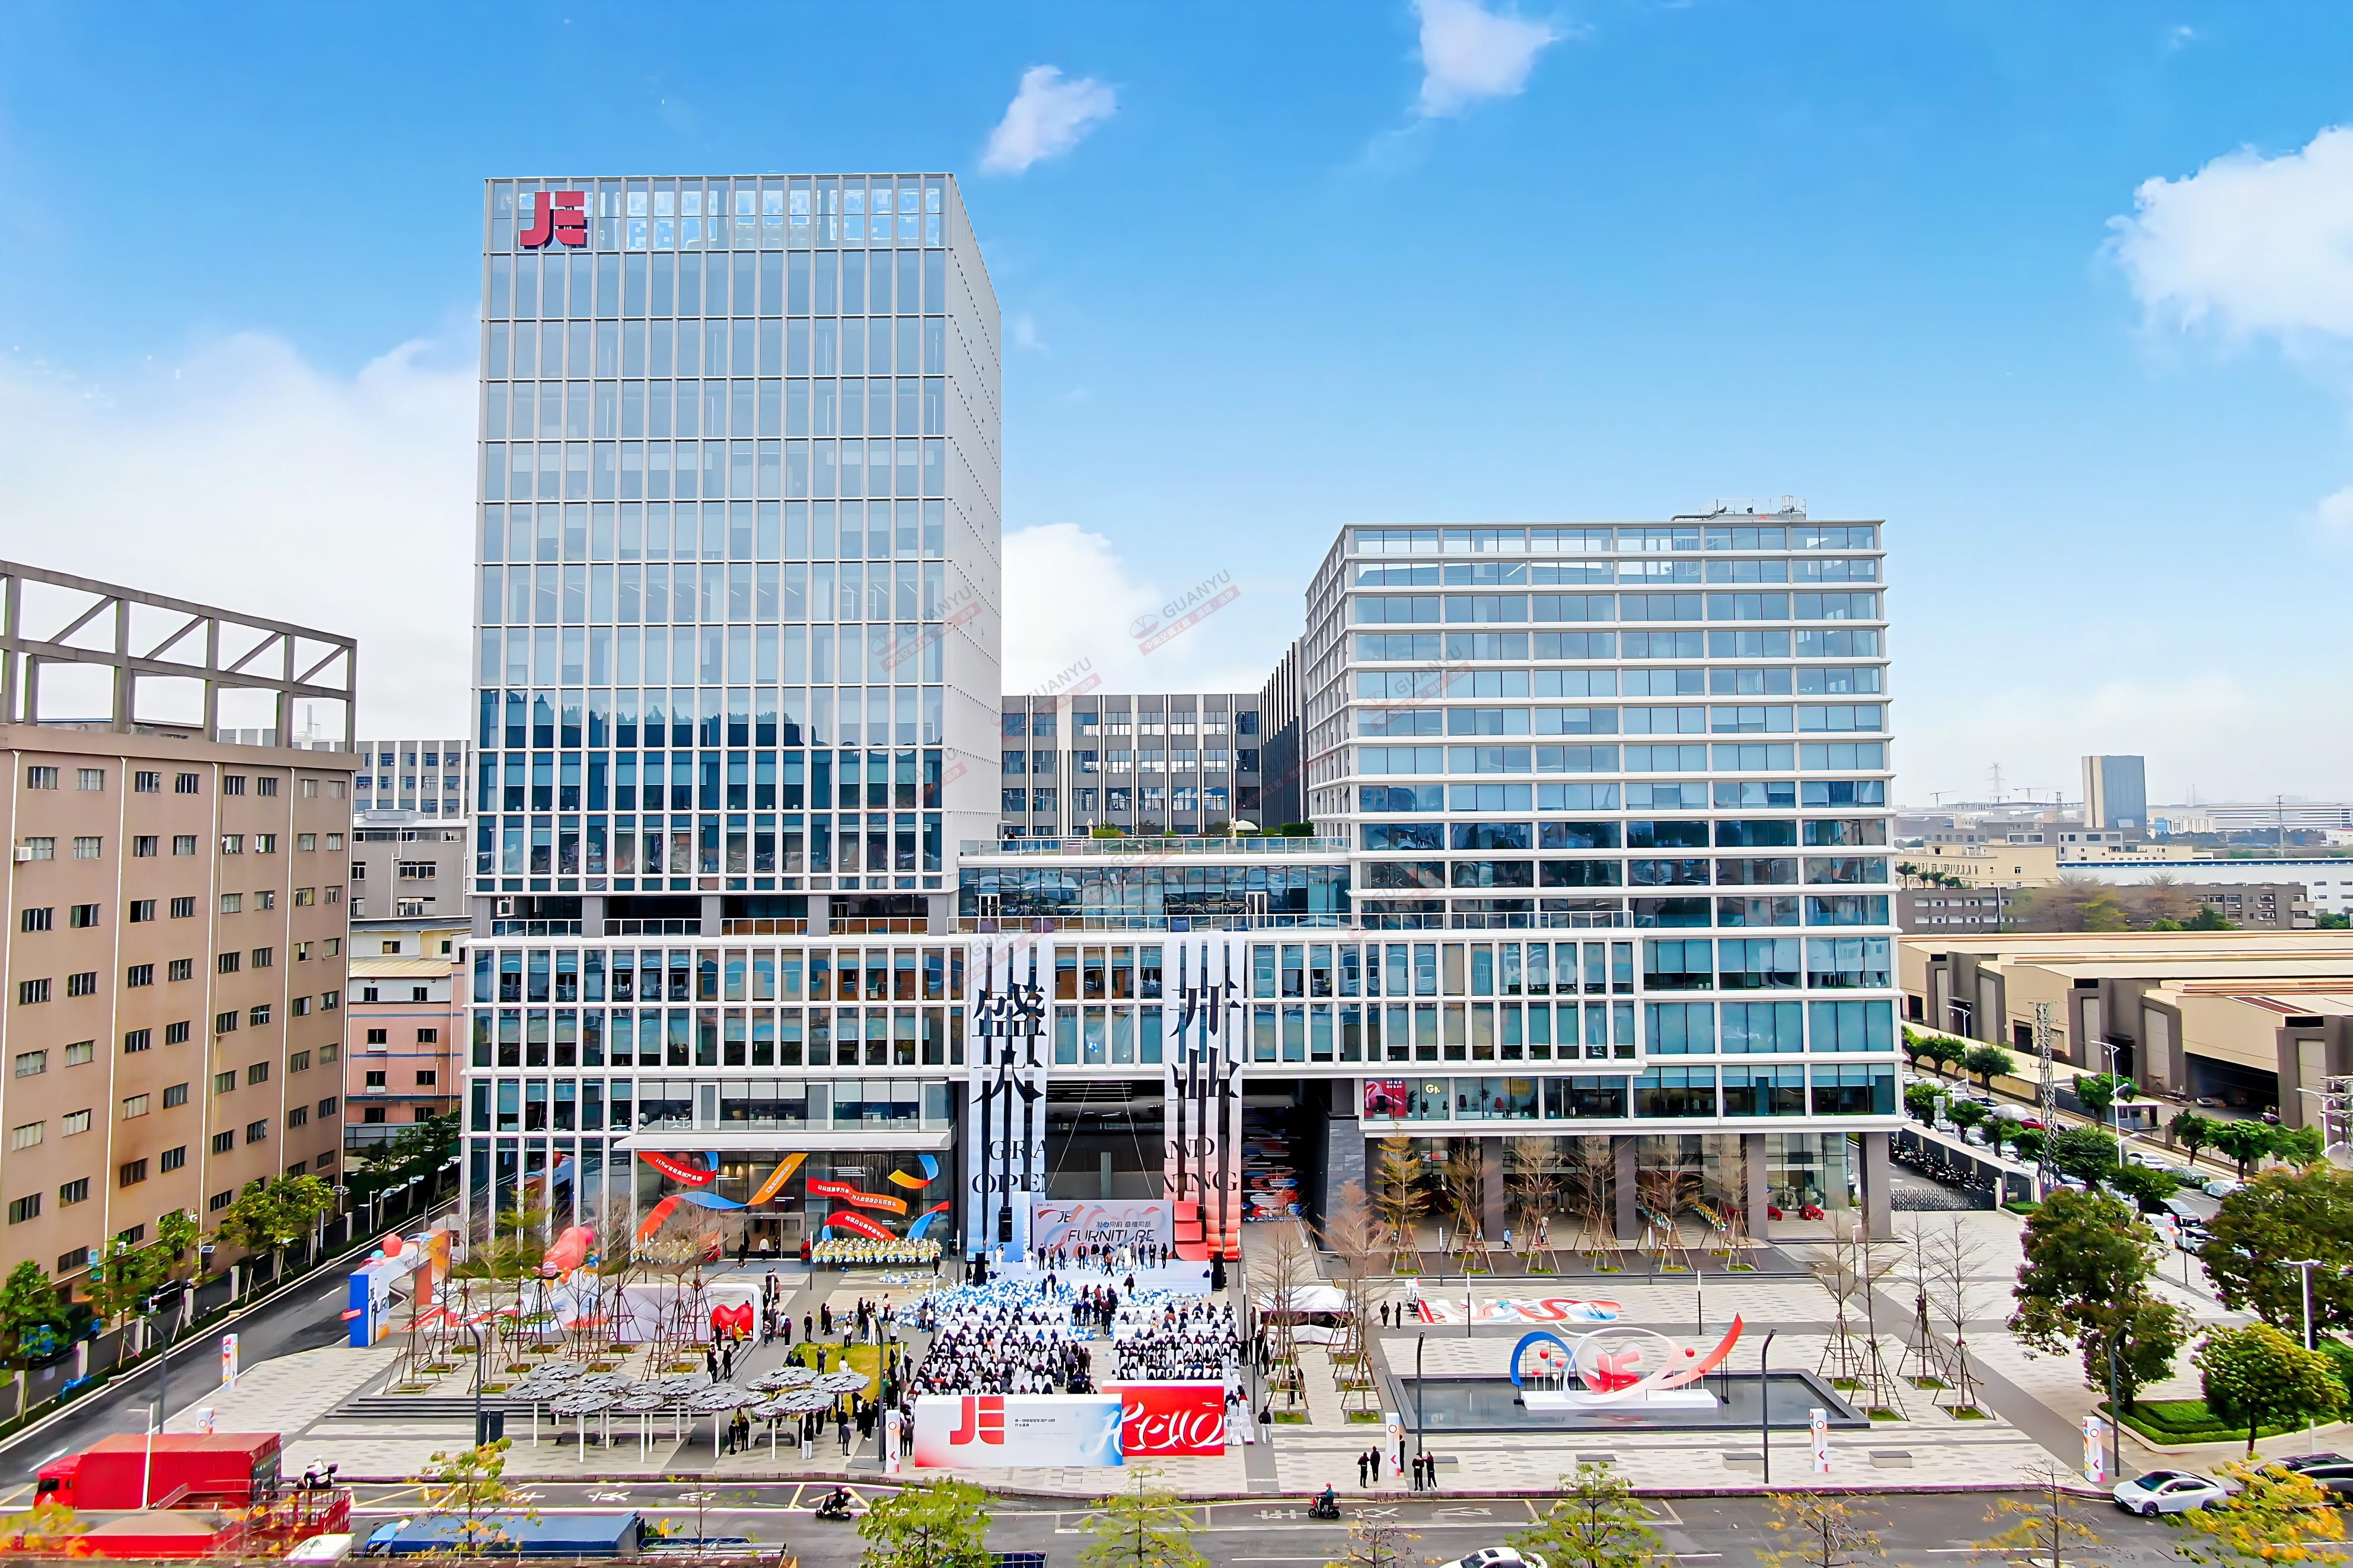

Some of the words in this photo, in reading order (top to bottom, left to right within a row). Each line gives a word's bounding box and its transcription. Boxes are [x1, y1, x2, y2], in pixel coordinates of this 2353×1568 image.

[520, 191, 585, 246] JE
[972, 982, 1047, 1104] 盛大
[1161, 979, 1242, 1101] 开业
[950, 1395, 1005, 1445] JE
